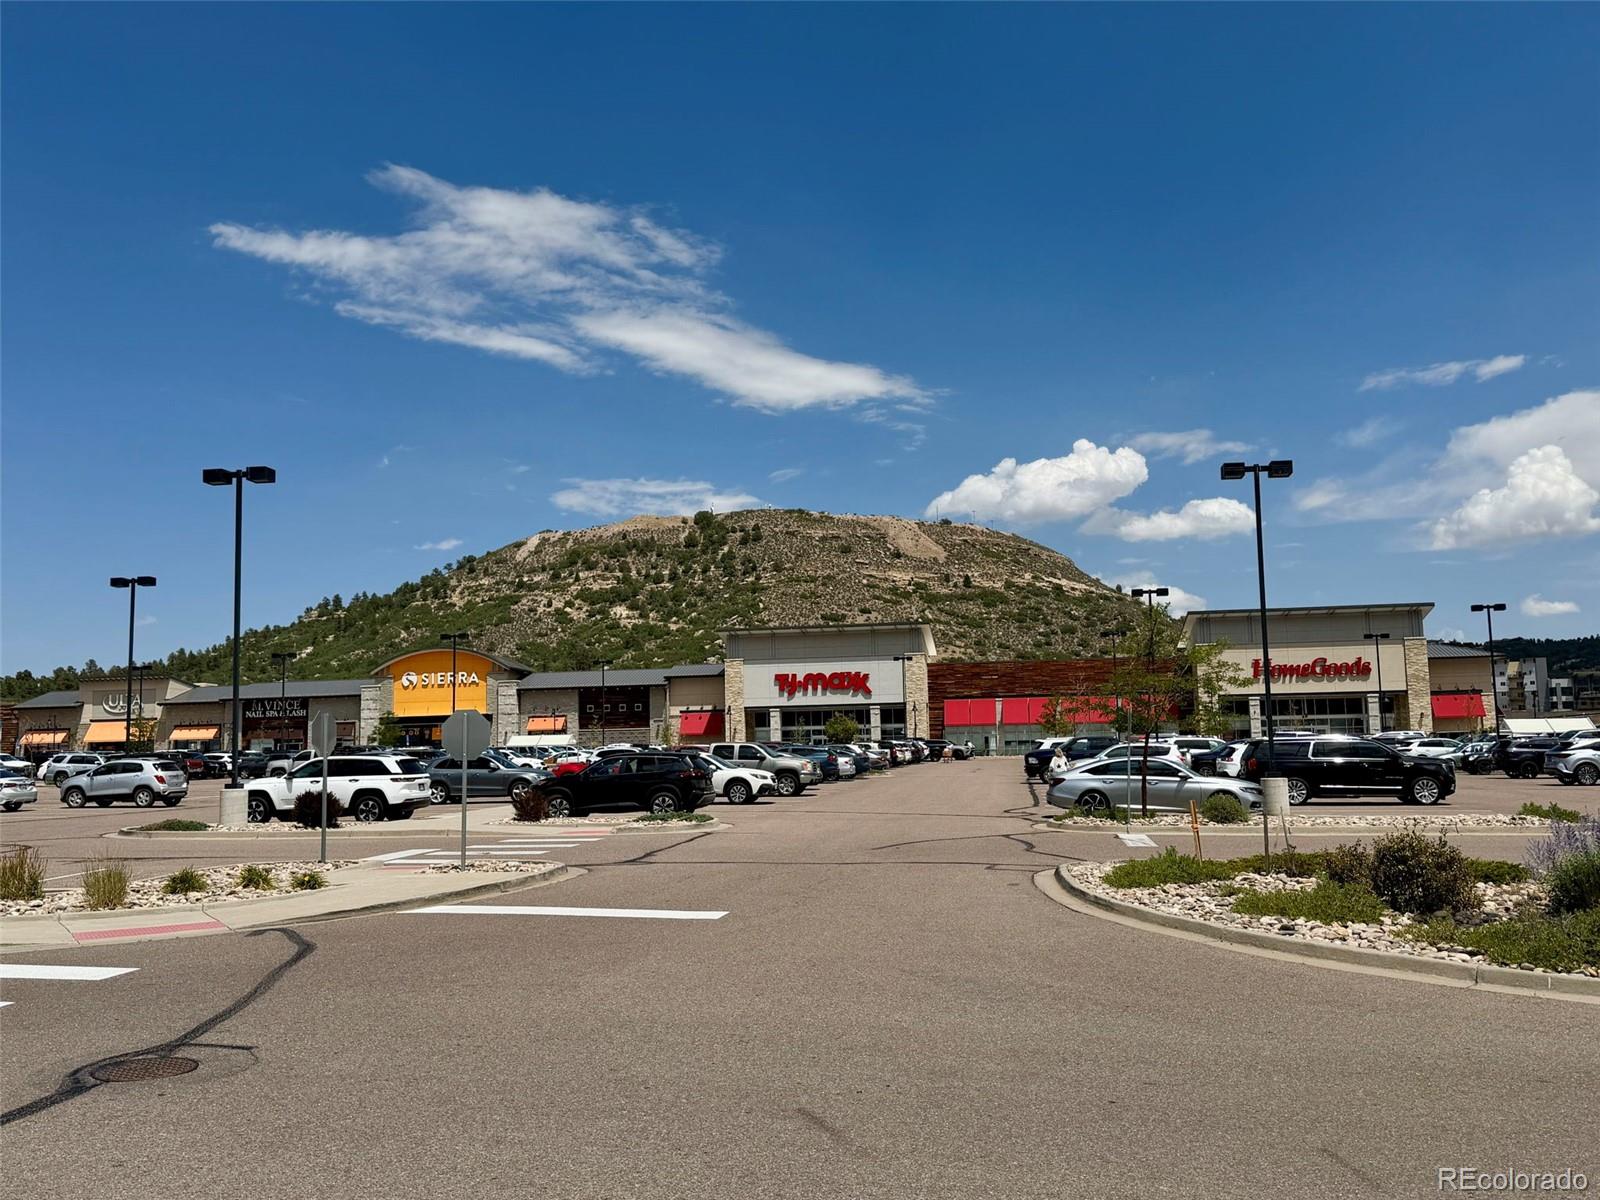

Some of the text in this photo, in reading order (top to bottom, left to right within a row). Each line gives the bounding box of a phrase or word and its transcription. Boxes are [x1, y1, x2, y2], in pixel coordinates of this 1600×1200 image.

[1251, 656, 1372, 678] HomeGoods
[421, 671, 479, 685] SIERRA
[245, 710, 264, 718] NAIL
